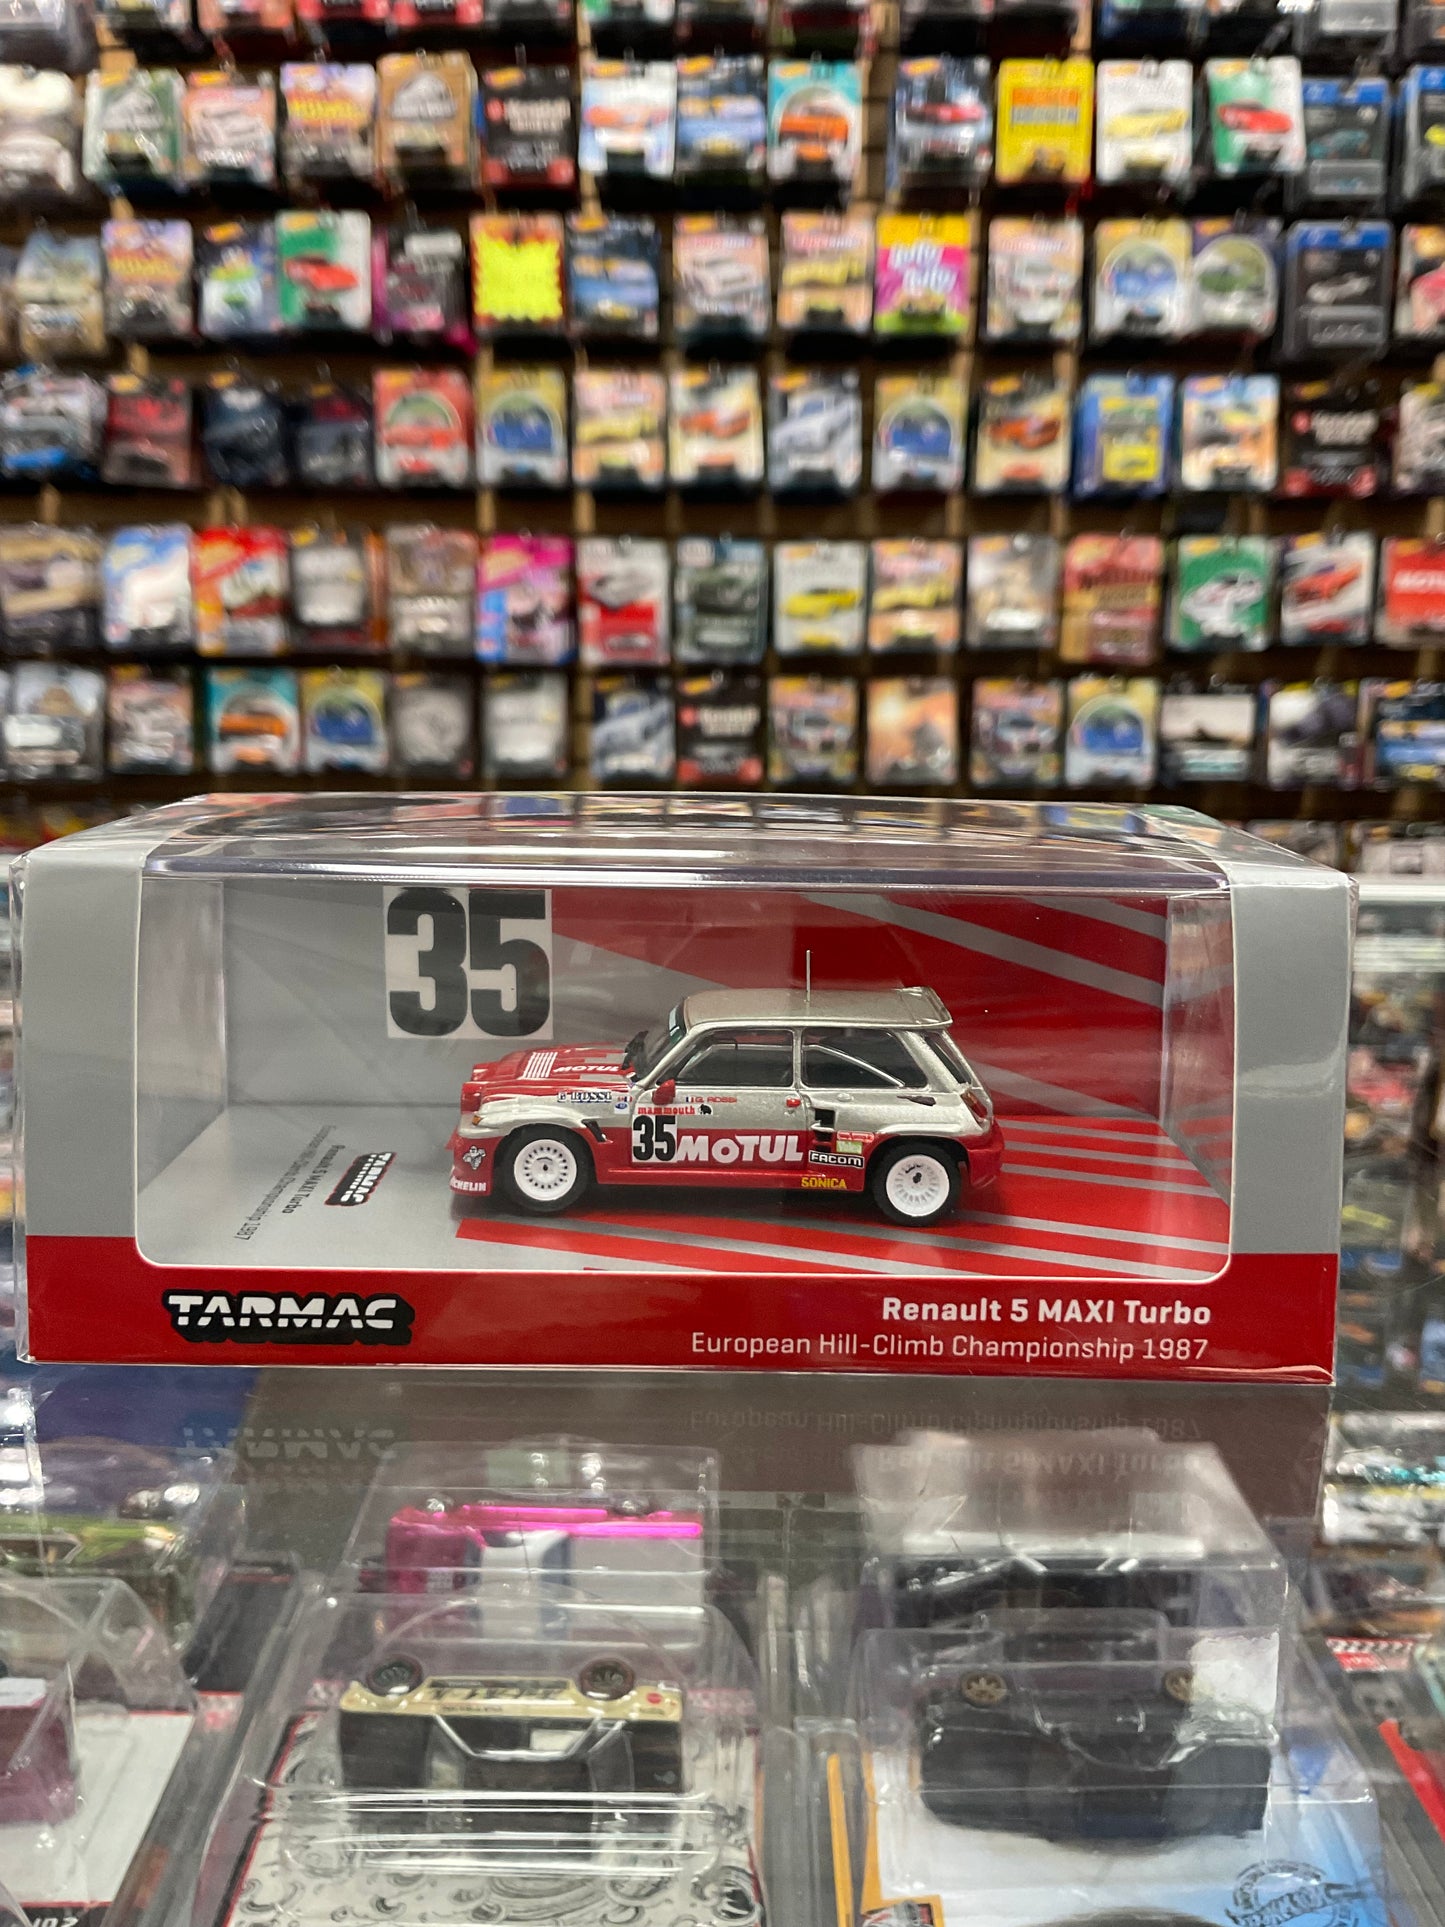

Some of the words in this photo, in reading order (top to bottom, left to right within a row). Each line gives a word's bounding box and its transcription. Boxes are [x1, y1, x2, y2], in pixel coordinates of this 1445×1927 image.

[388, 887, 550, 1036] 35
[553, 1065, 619, 1073] MOTUL
[637, 1106, 695, 1115] mammouth
[633, 1115, 676, 1161] 35
[677, 1134, 804, 1164] MOTUL
[801, 1177, 847, 1189] SONICA
[169, 1295, 396, 1329] TARMAC
[882, 1297, 1002, 1322] Renault
[1011, 1298, 1029, 1322] 5
[1039, 1299, 1115, 1323] MAXI
[1124, 1300, 1211, 1325] Turbo
[692, 1332, 811, 1358] European
[819, 1333, 944, 1356] Hill-Climb
[953, 1335, 1134, 1364] Championship
[1143, 1338, 1208, 1360] 1987
